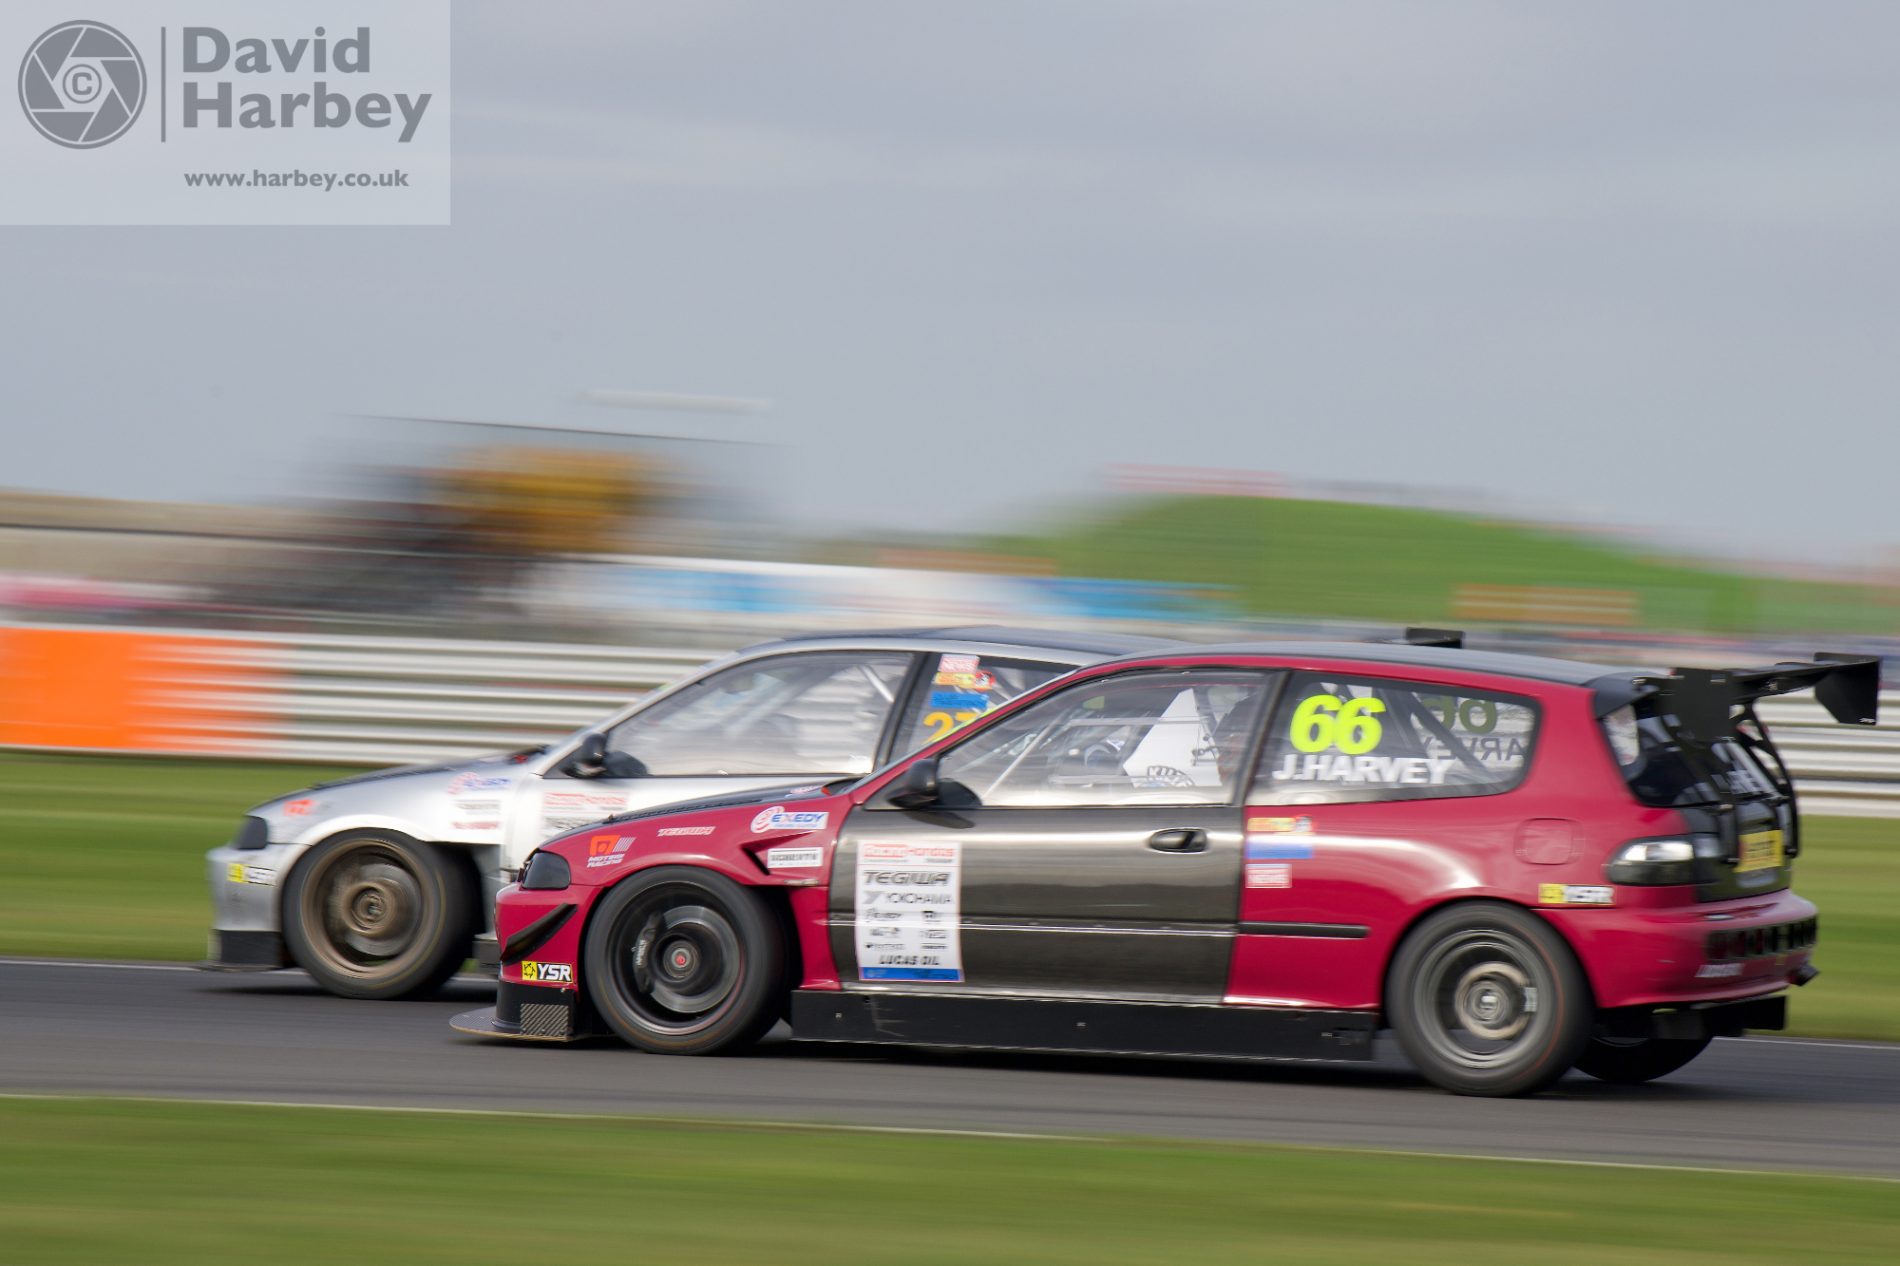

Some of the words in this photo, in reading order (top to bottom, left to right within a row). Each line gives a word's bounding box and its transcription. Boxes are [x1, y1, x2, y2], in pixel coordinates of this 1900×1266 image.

[1290, 694, 1386, 755] 66
[1272, 754, 1455, 784] J.HARVEY
[771, 813, 825, 823] EXEDY
[864, 871, 950, 885] TEGIWA
[880, 955, 918, 965] LUCAS
[920, 956, 940, 965] OIL
[537, 963, 571, 981] YSR
